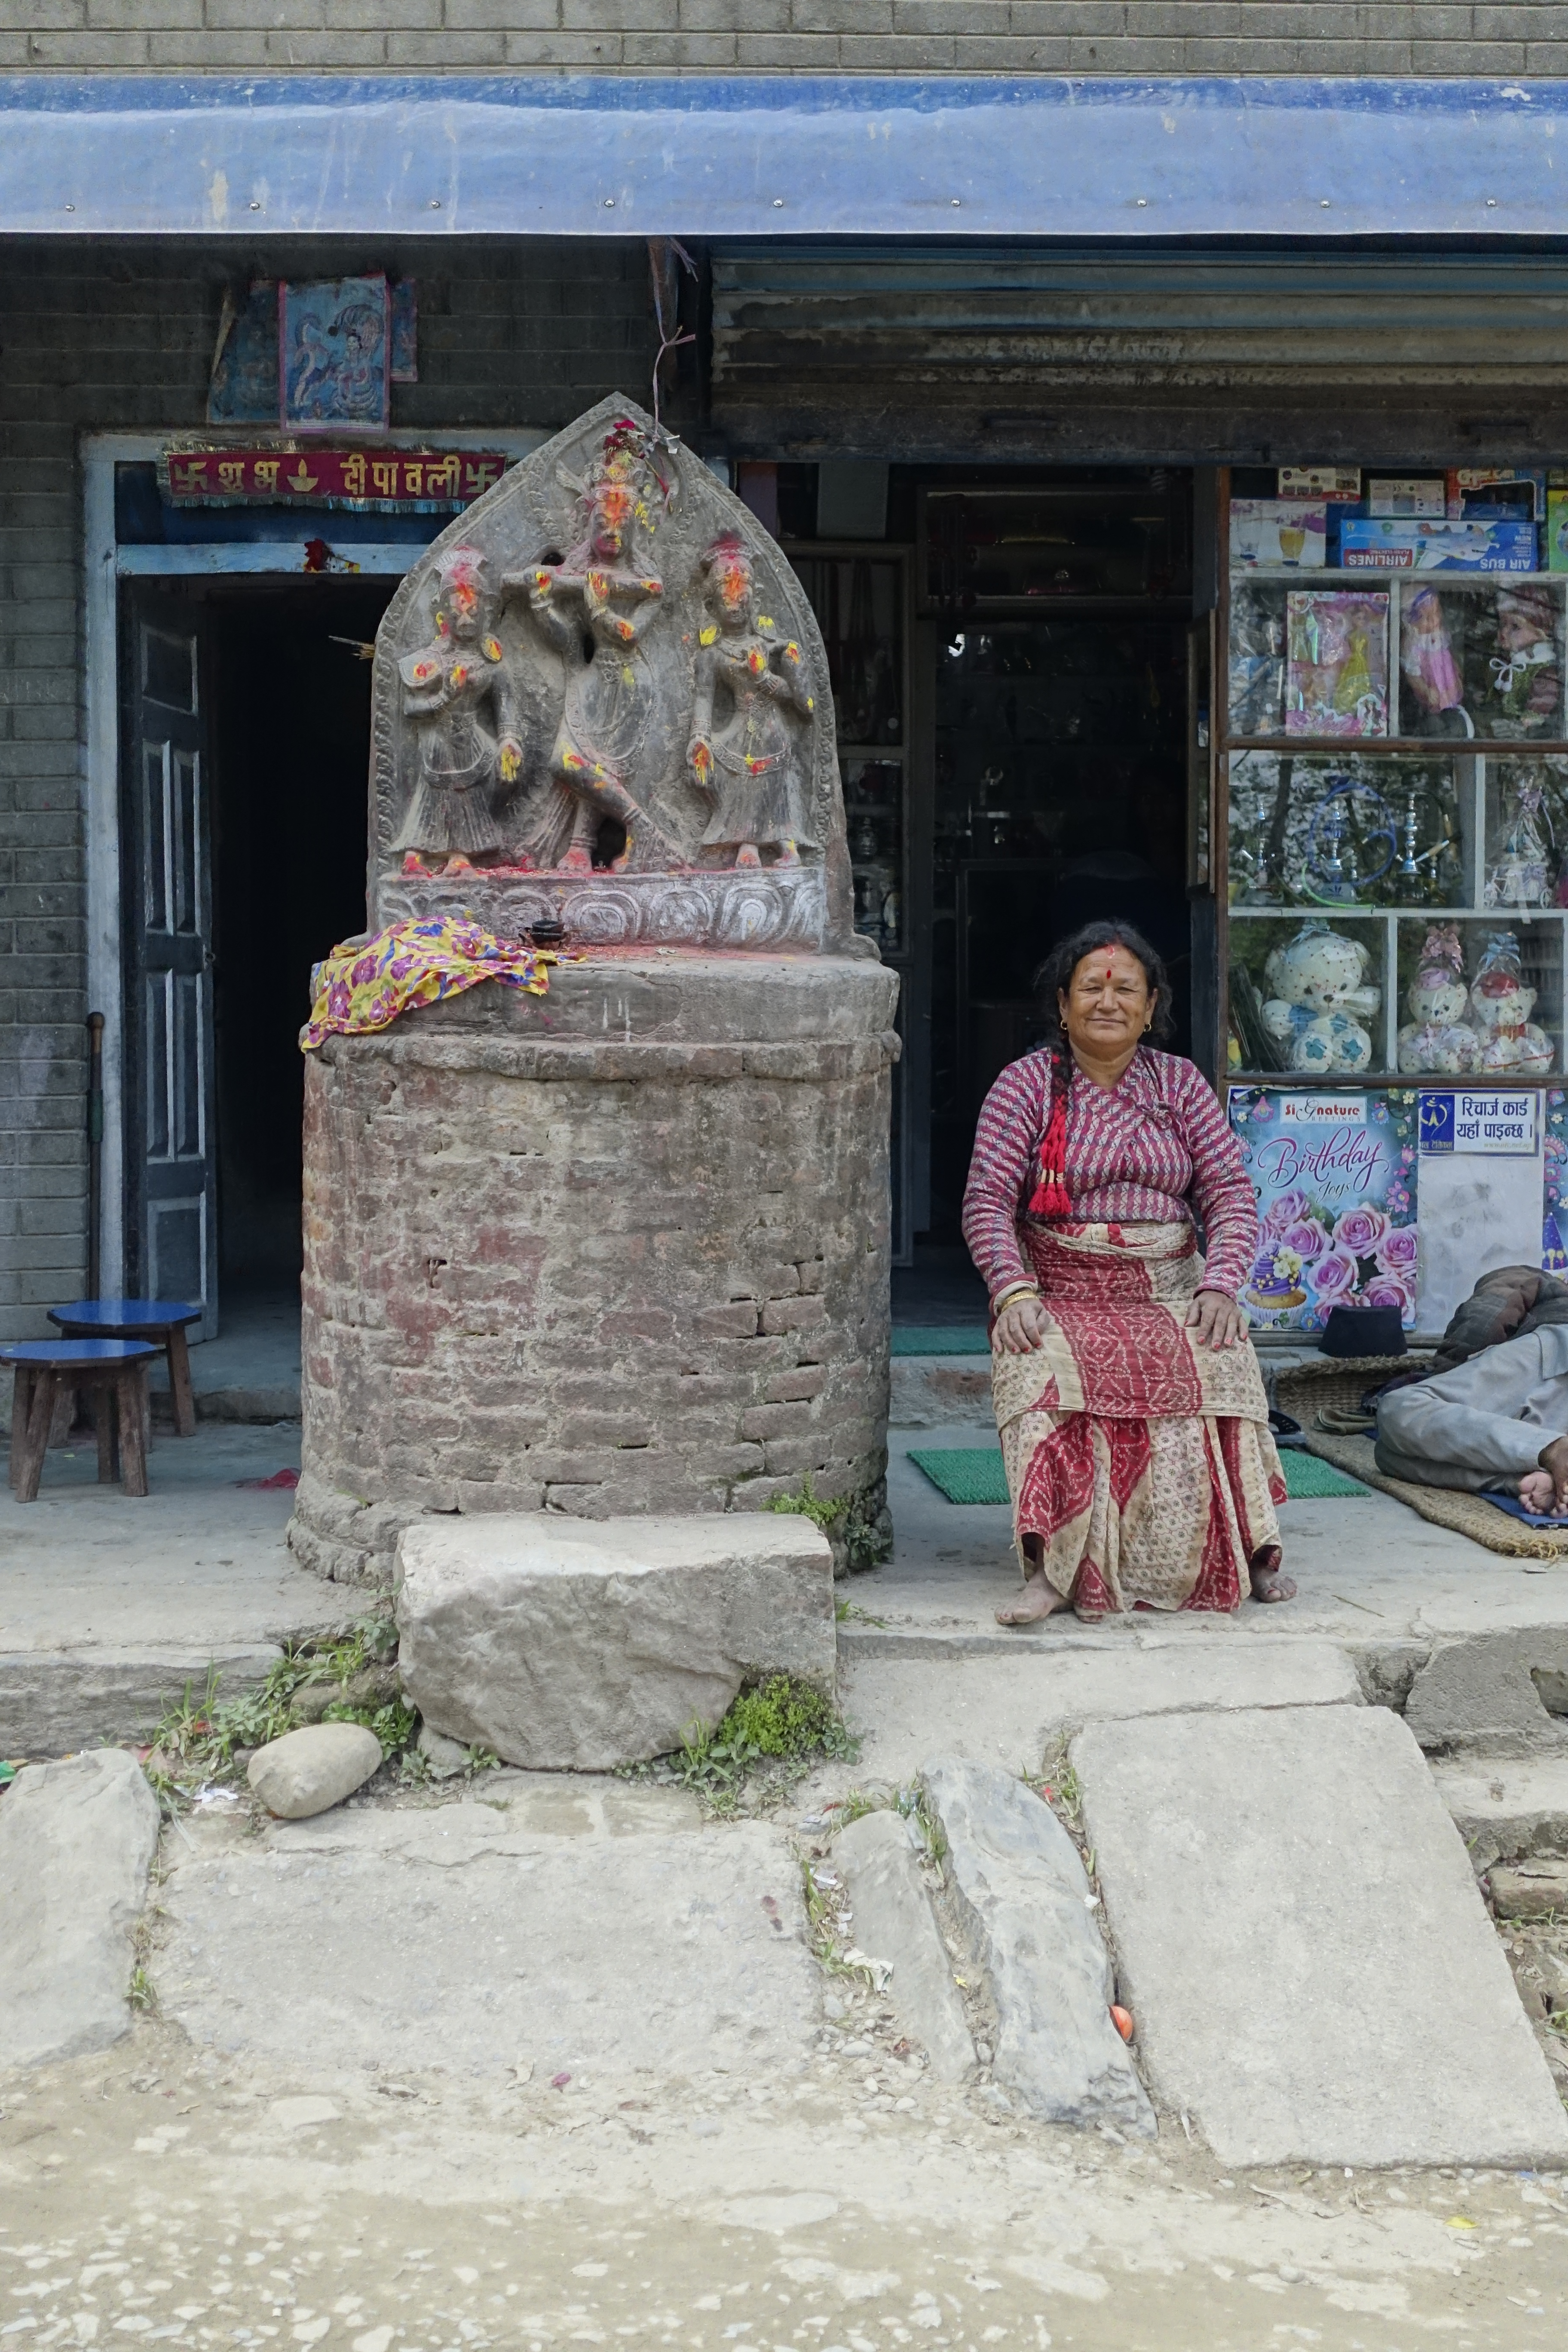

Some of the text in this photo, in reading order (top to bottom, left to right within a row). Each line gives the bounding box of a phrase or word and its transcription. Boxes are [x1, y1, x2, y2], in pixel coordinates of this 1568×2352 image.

[340, 453, 462, 497] दीपावली
[1348, 554, 1408, 566] AIRLINES
[1479, 558, 1531, 570] AIR BUS
[1462, 1096, 1529, 1117] रिचार्ज कार्ड
[1456, 1118, 1480, 1139] यहाँ
[1484, 1123, 1524, 1141] पाइन्छ
[1257, 1127, 1389, 1192] Birthday
[1317, 1179, 1352, 1203] Joys
